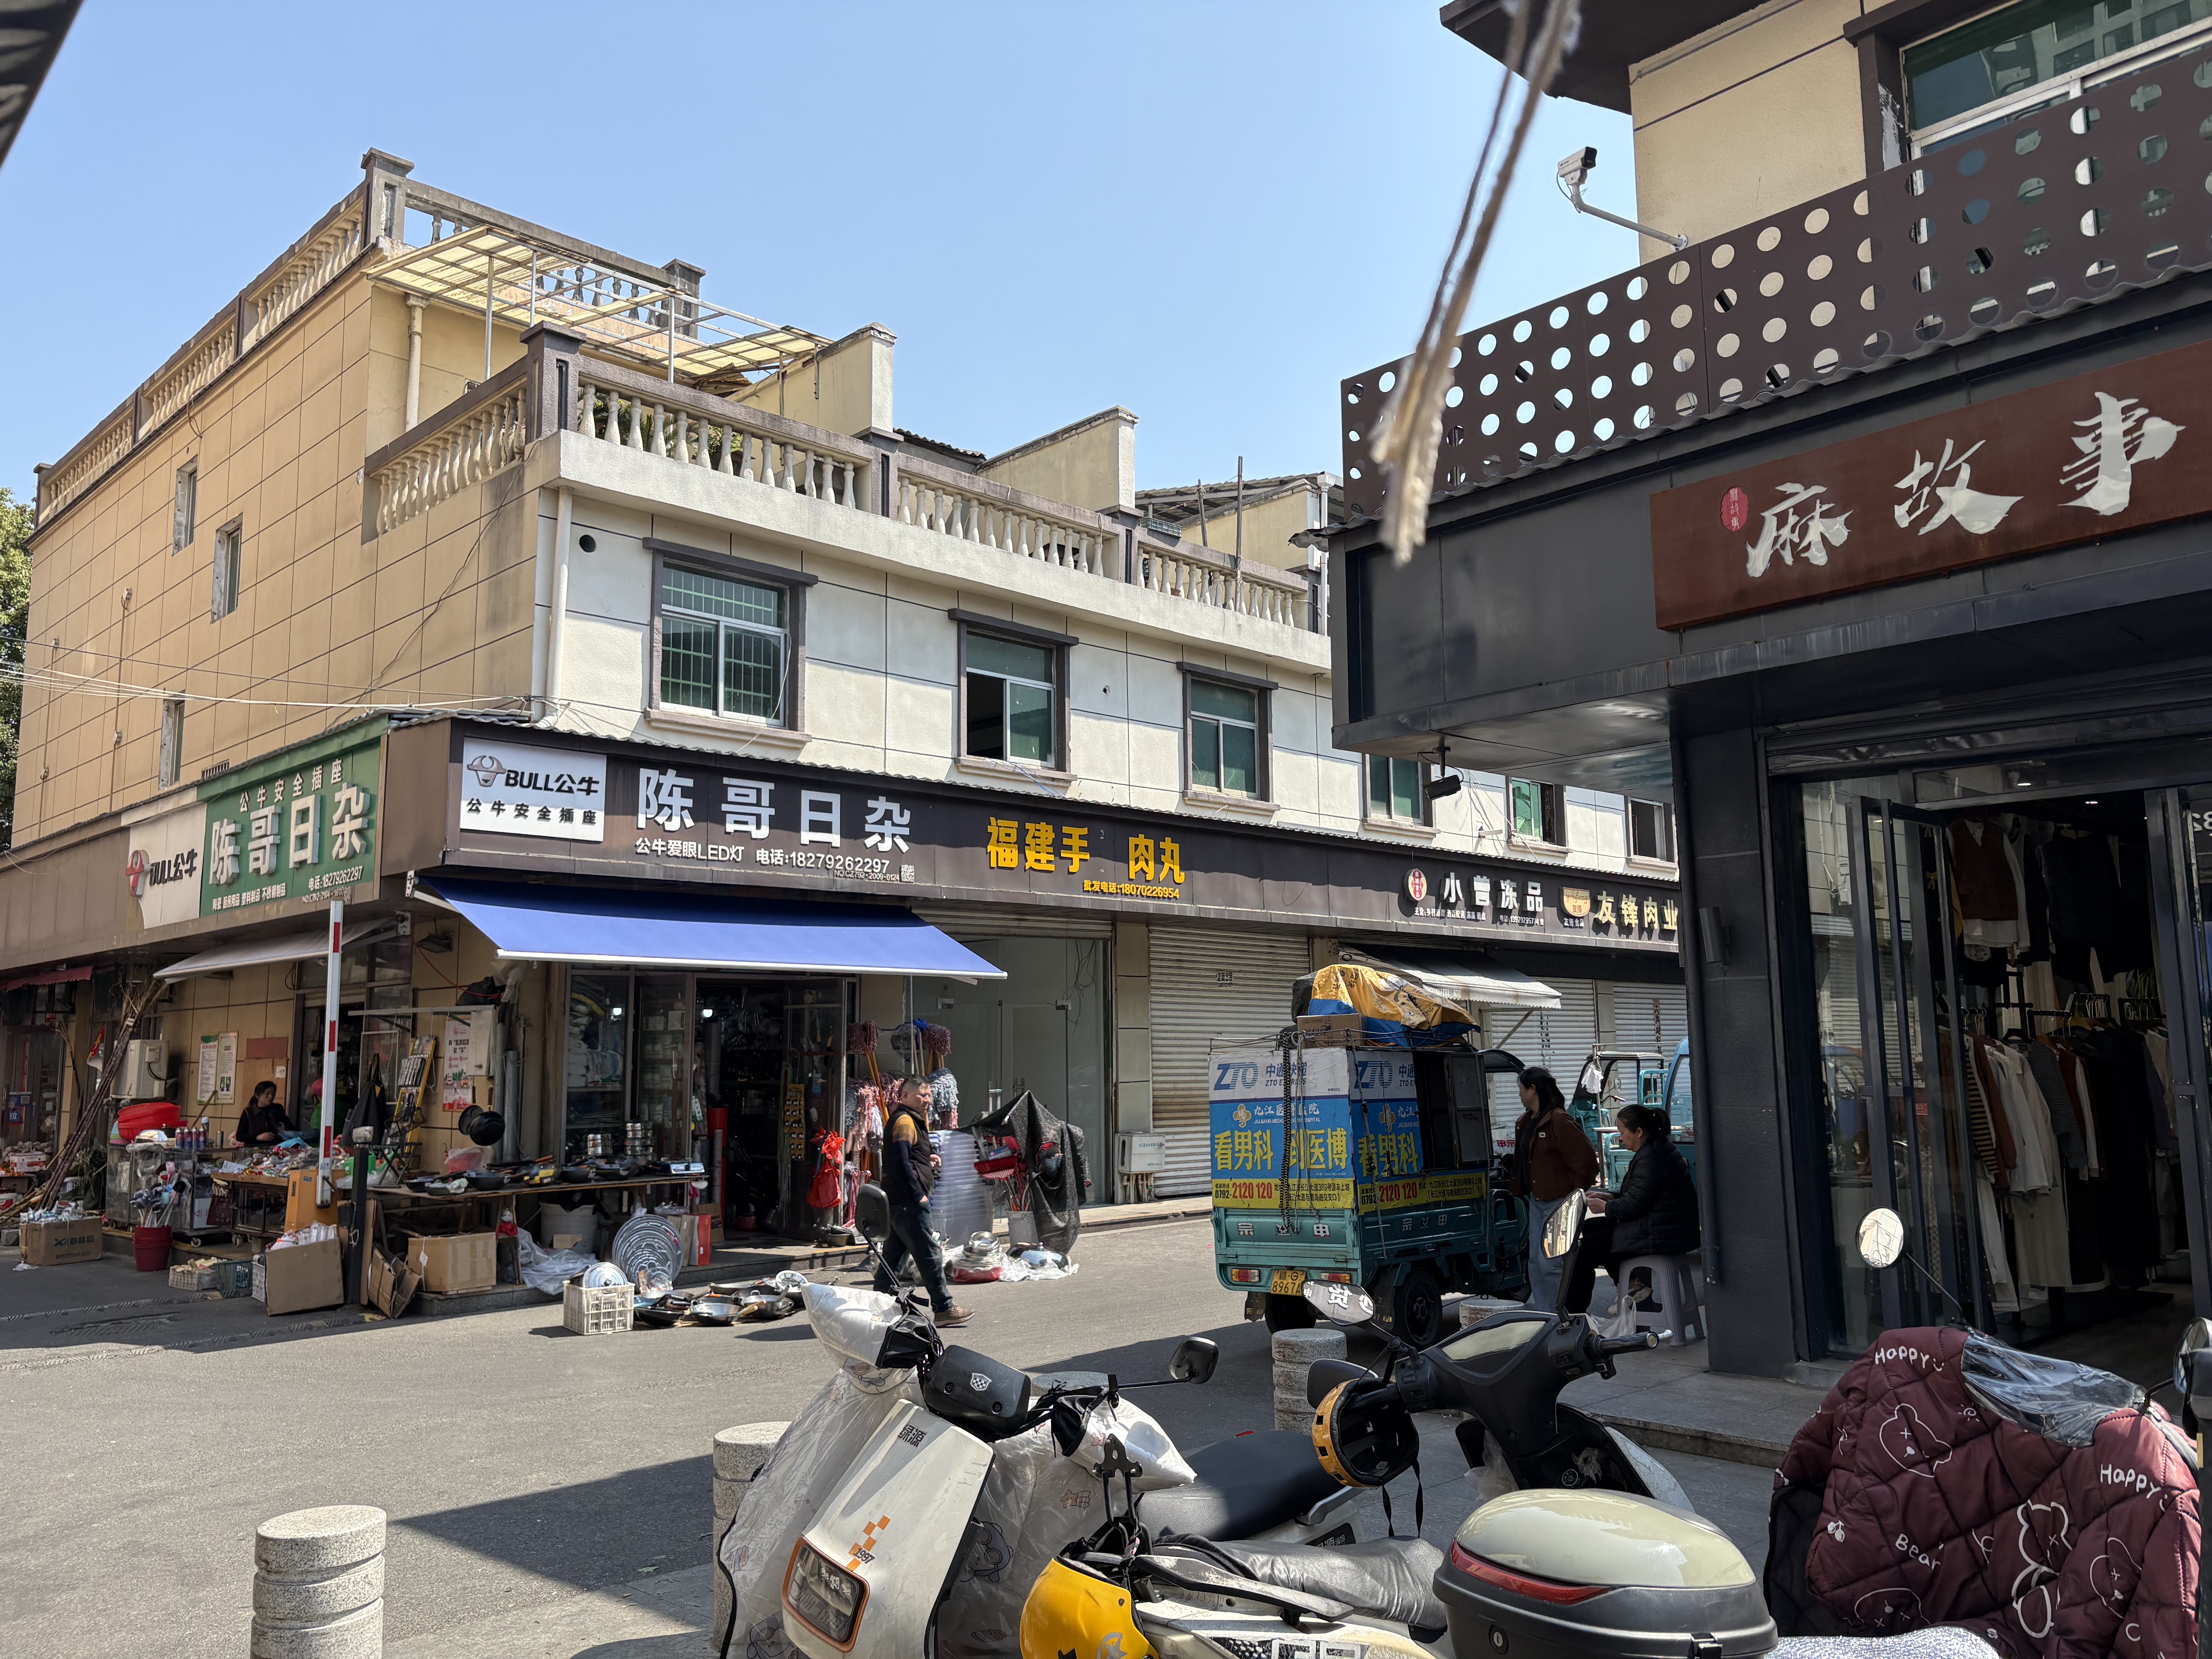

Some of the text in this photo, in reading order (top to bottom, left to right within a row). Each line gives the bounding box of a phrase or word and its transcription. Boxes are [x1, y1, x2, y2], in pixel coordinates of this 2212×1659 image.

[1746, 392, 2185, 577] 麻故事
[240, 758, 342, 812] 公牛安全插座
[505, 769, 599, 796] BULL公牛
[467, 798, 596, 825] 公牛安全插座
[637, 768, 911, 854] 陈哥日杂
[209, 782, 370, 885] 陈哥日杂
[635, 837, 745, 862] 公牛爱眼LED灯
[1594, 891, 1678, 930] 友锋肉业
[1214, 1062, 1259, 1091] ZTO
[1354, 1061, 1393, 1089] ZTO
[1214, 1129, 1274, 1170] 看男科
[1272, 1281, 1302, 1295] 8967A
[897, 1424, 927, 1448] 绿源
[853, 1548, 875, 1564] 1997
[1895, 1534, 1941, 1570] Bear
